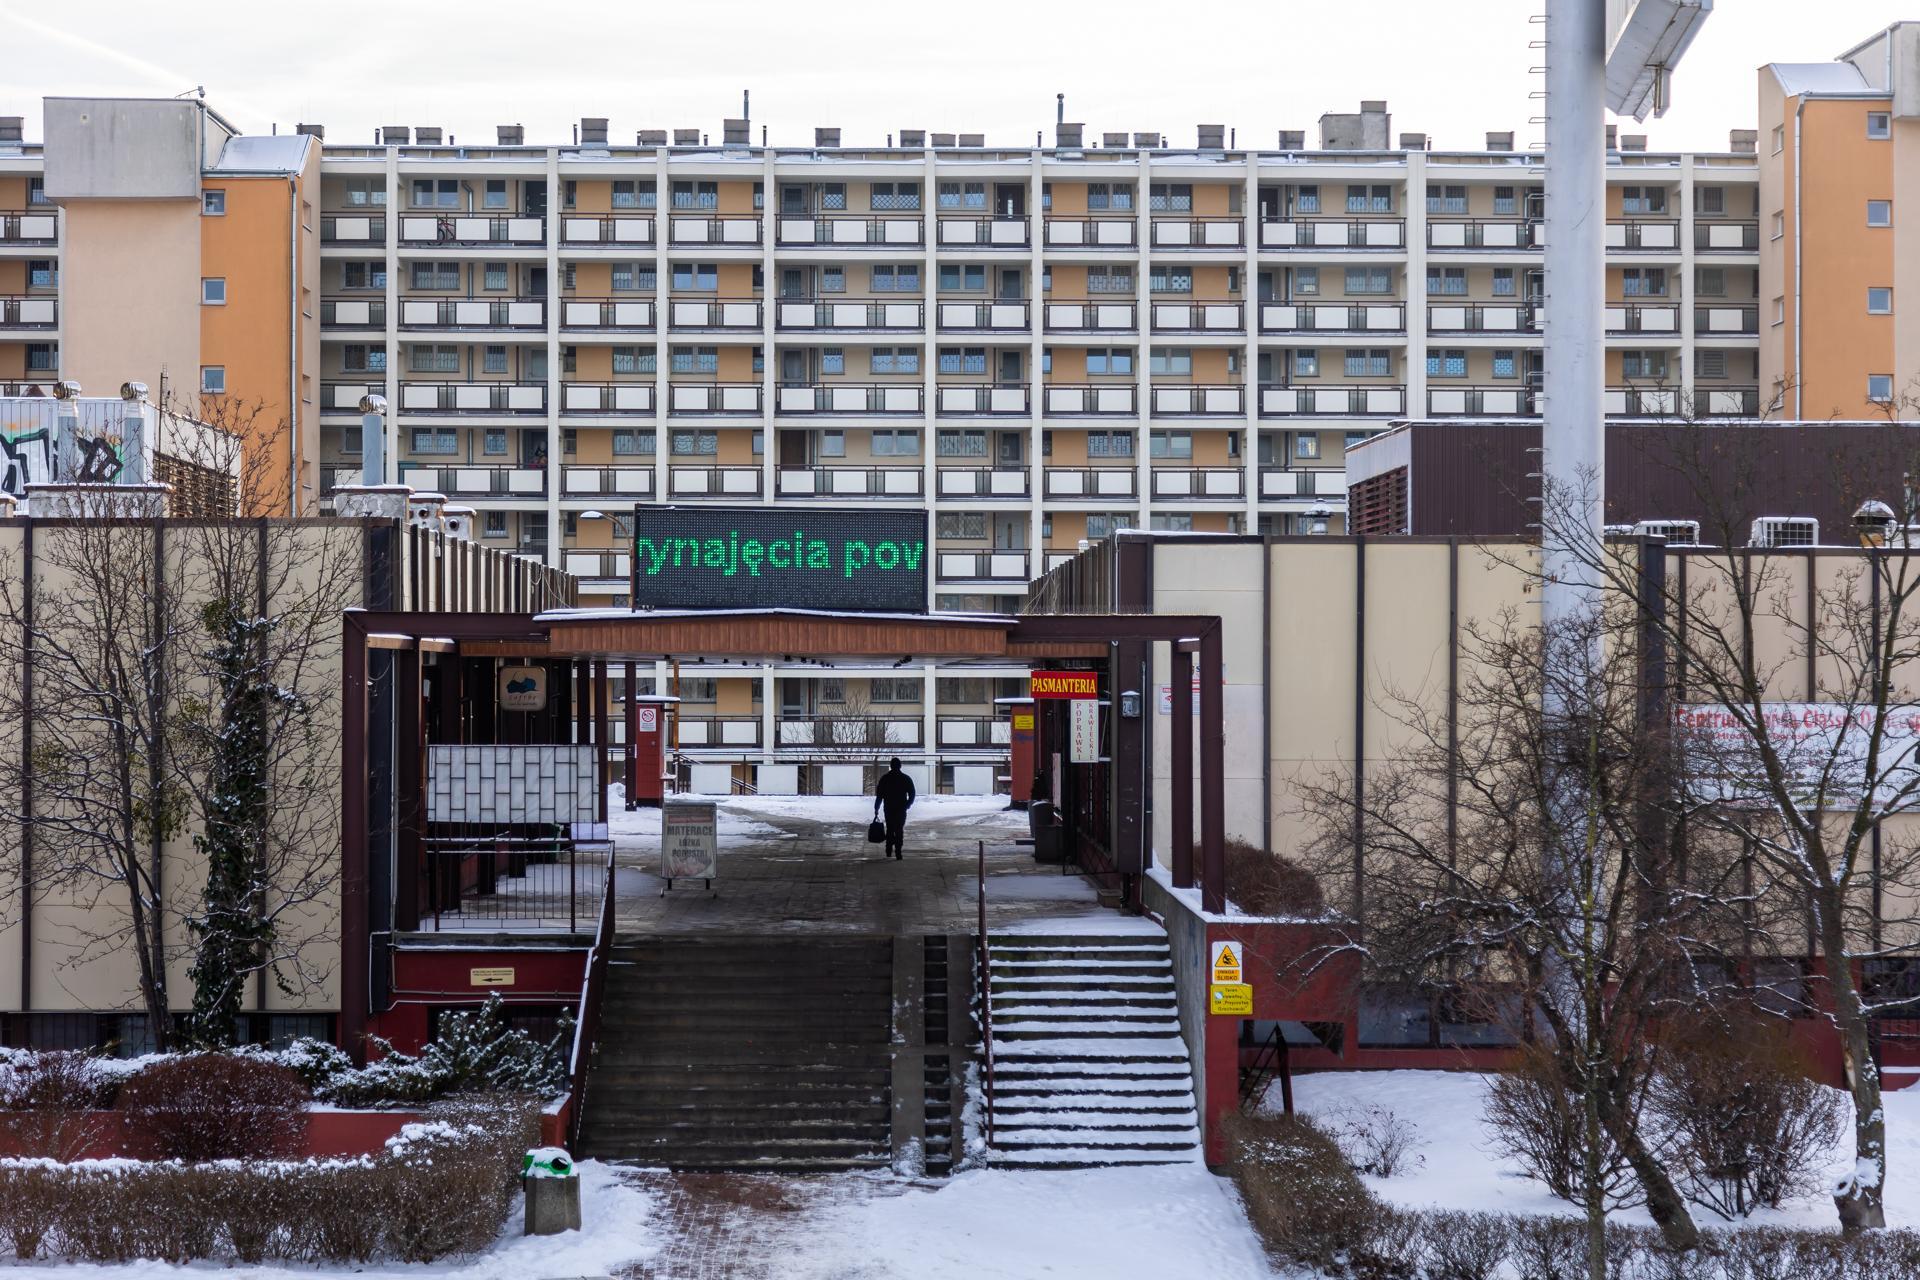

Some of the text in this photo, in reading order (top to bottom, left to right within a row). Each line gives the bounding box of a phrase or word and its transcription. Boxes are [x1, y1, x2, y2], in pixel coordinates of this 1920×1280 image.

[1031, 677, 1096, 694] PASMANTERIA
[1075, 702, 1083, 761] POPRAWKI
[1087, 702, 1095, 761] KRAWIECKIE
[666, 825, 713, 836] MATERACE
